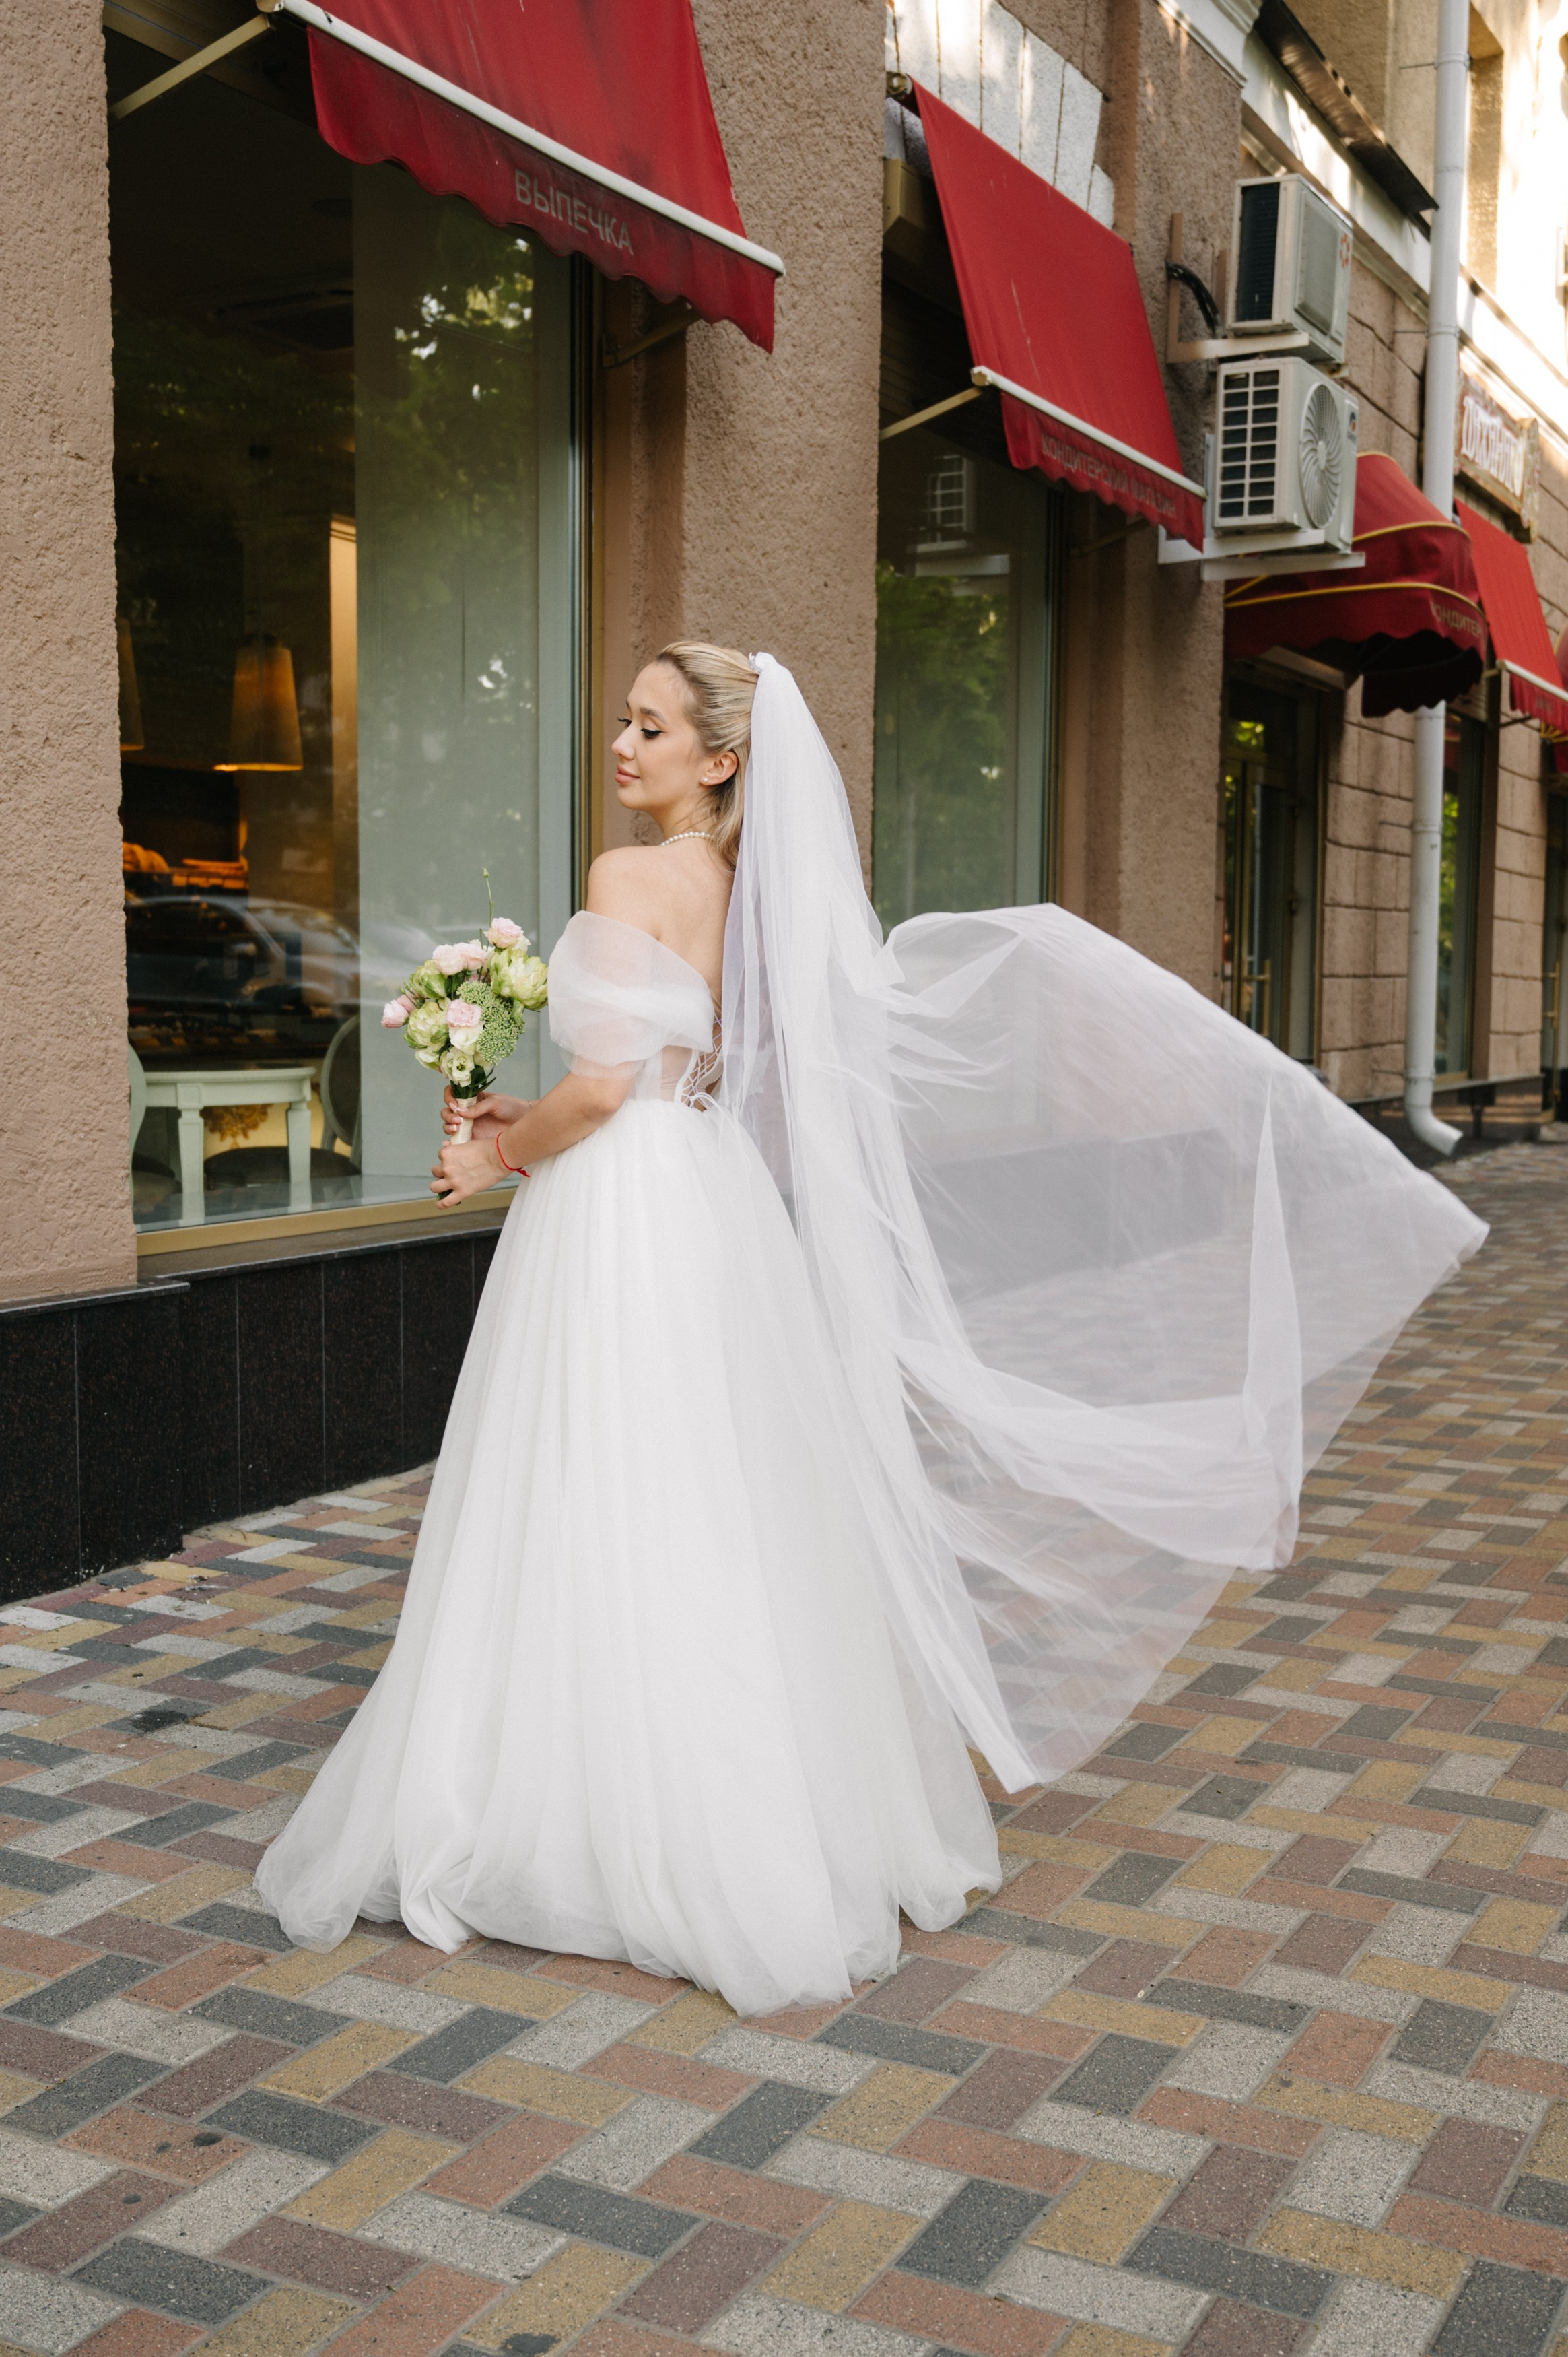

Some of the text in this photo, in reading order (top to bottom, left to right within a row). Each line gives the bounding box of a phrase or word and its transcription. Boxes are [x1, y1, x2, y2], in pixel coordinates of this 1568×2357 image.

[514, 168, 634, 256] ВЫПЕЧКА
[1042, 435, 1177, 519] КОНДИТЕРСКИЙ МАГАЗИН
